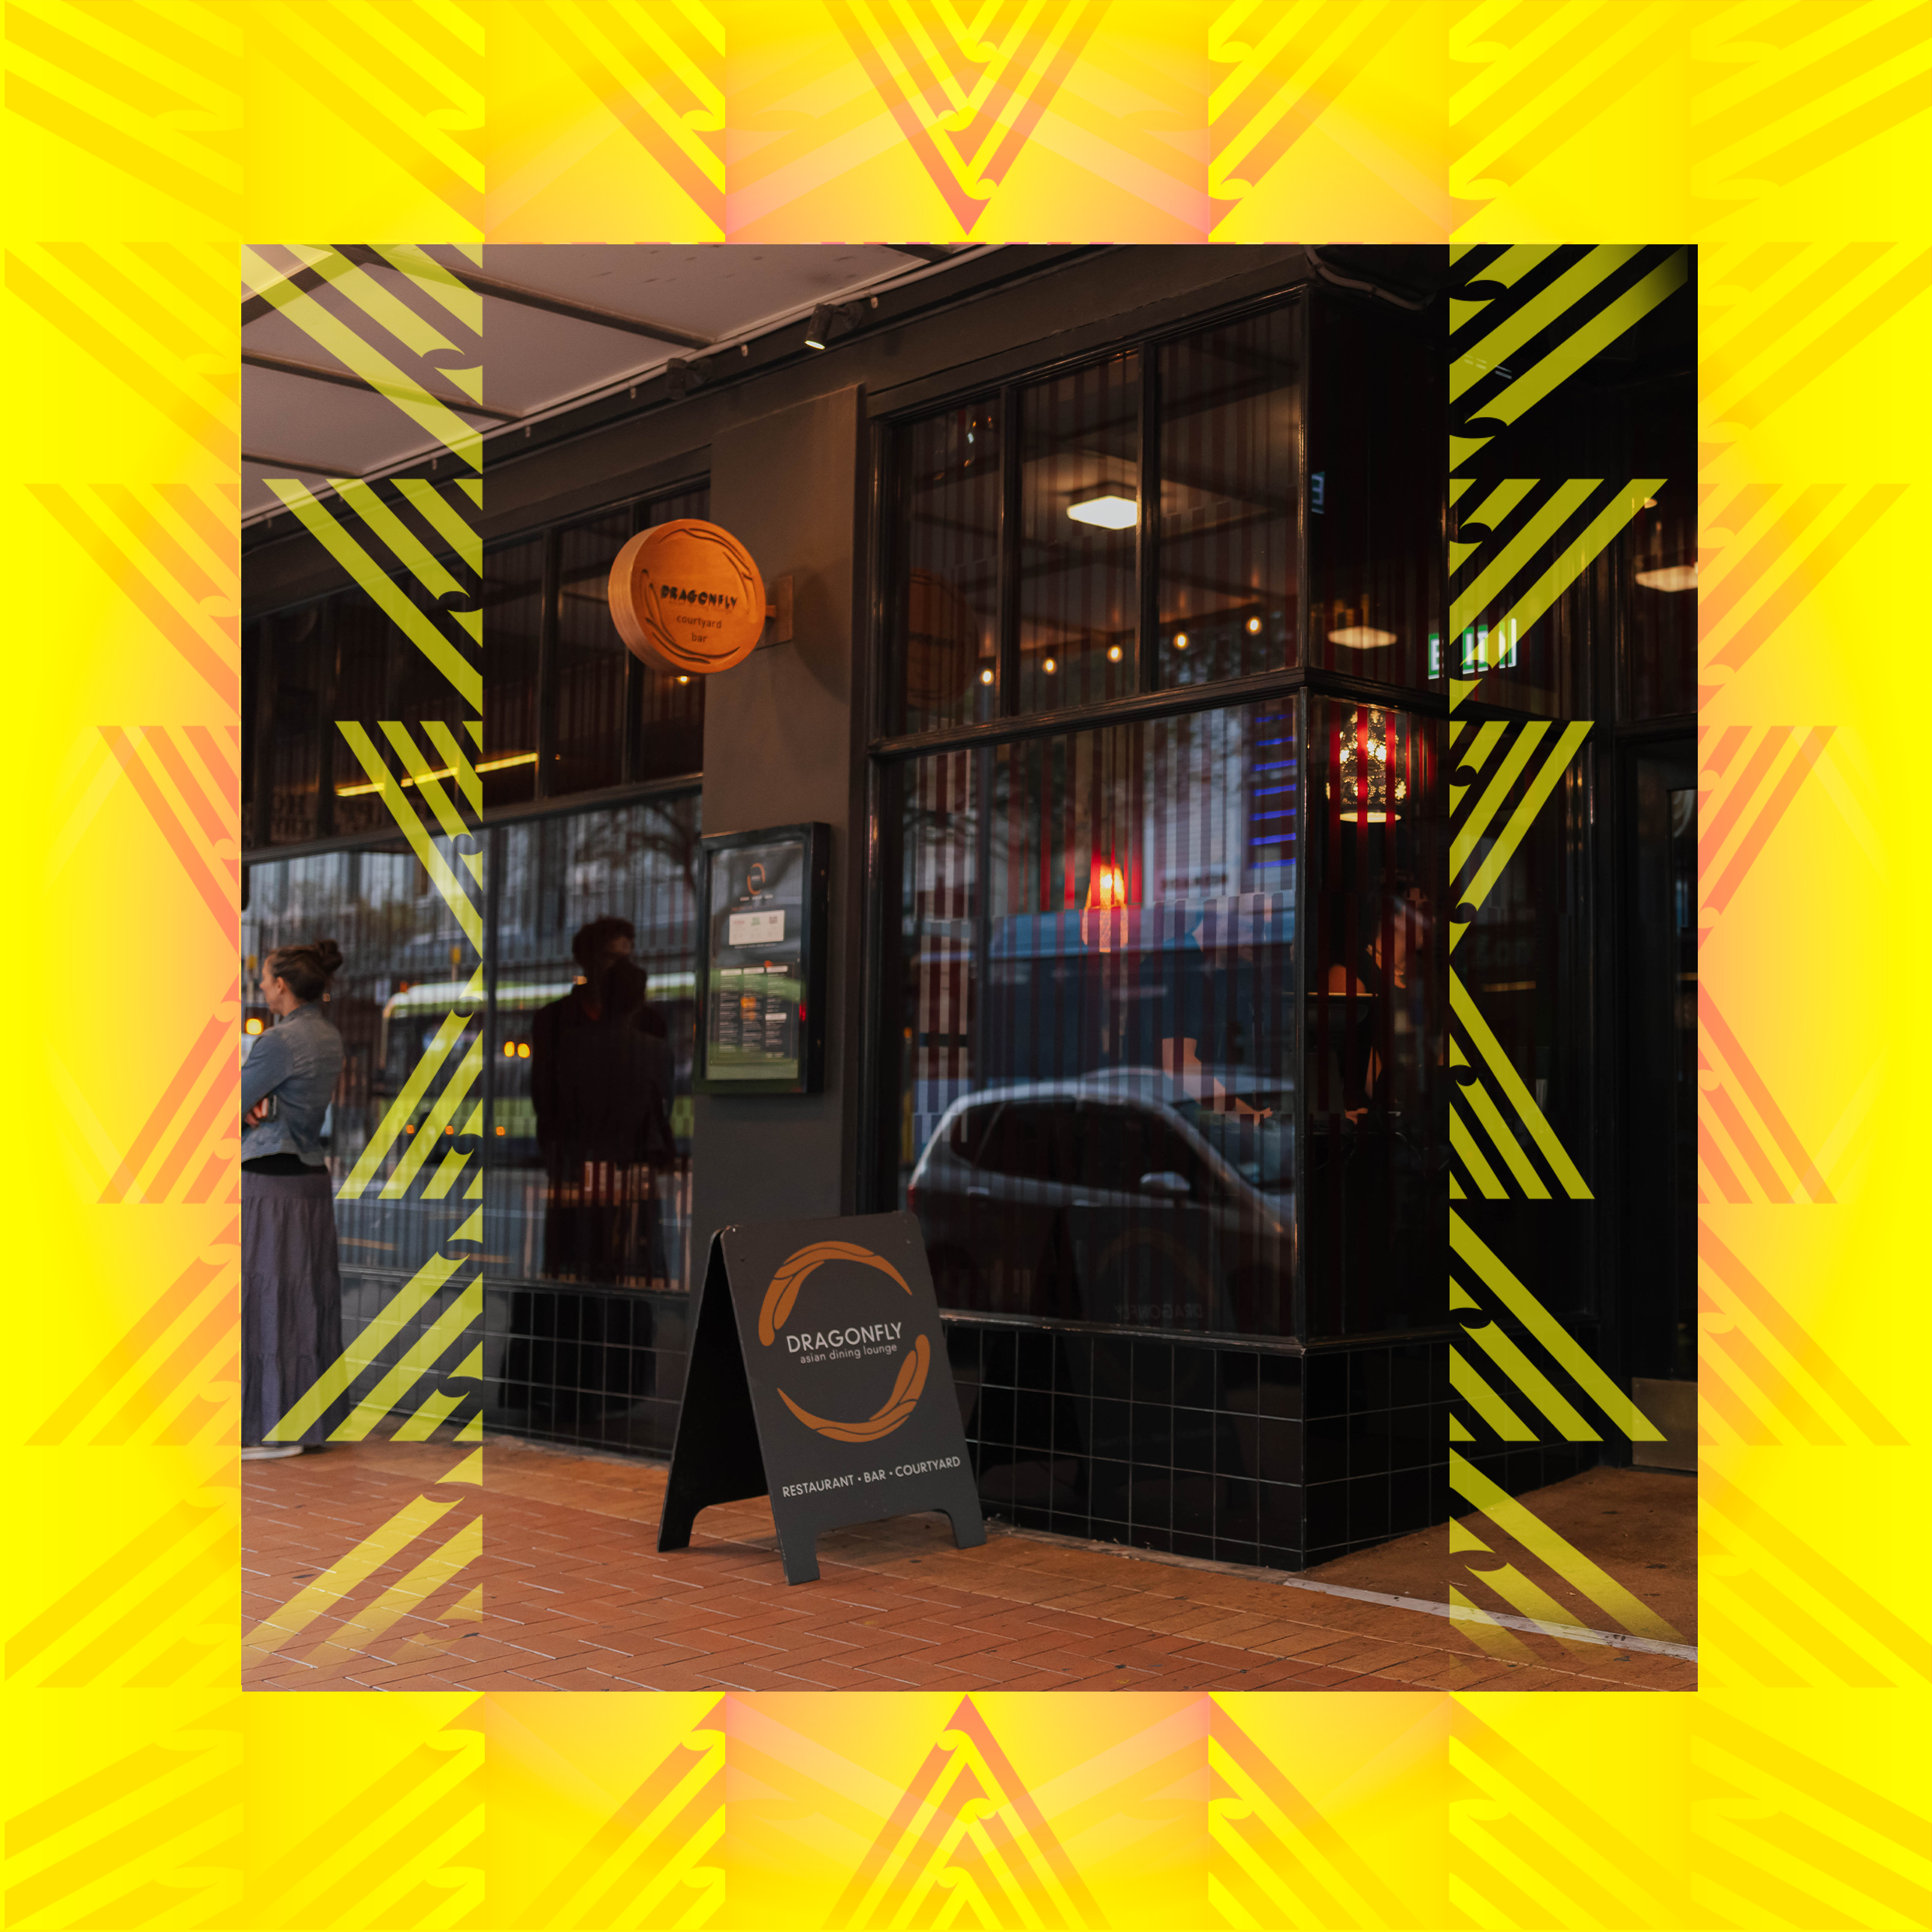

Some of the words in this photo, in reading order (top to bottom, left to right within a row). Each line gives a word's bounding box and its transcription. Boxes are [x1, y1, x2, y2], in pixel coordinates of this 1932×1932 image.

[660, 585, 738, 609] DRAGONFLY
[676, 615, 722, 629] courtyard
[691, 633, 708, 643] bar
[1430, 630, 1488, 671] EIT
[786, 1322, 902, 1353] DRAGONFLY
[800, 1353, 826, 1364] asian
[829, 1348, 861, 1359] dining
[863, 1344, 897, 1355] lounge
[782, 1474, 854, 1497] RESTAURANT
[863, 1469, 886, 1483] BAR
[895, 1456, 961, 1478] COURTYARD
